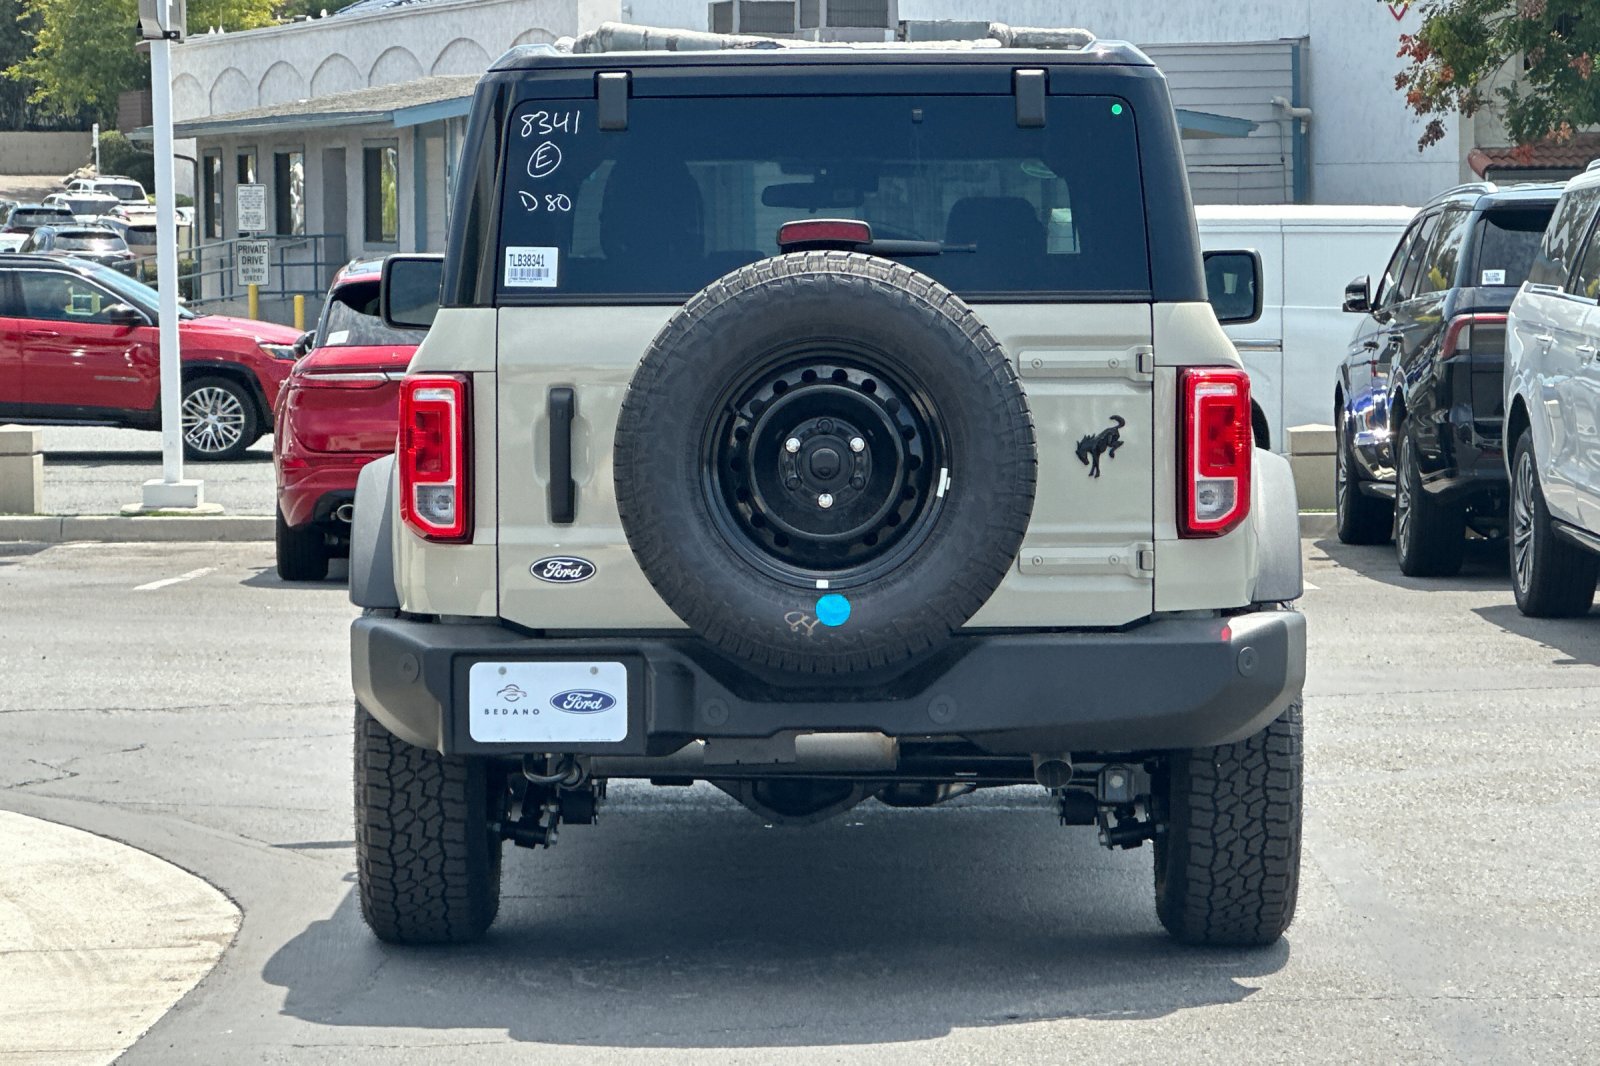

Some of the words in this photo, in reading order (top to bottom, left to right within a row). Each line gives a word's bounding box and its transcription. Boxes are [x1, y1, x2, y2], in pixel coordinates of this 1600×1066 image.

[520, 110, 580, 138] 8341
[545, 193, 572, 212] 80
[237, 244, 267, 255] PRIVATE
[241, 255, 265, 266] DRIVE
[508, 253, 545, 268] TLB38341
[543, 560, 583, 578] Ford
[562, 692, 603, 710] Ford
